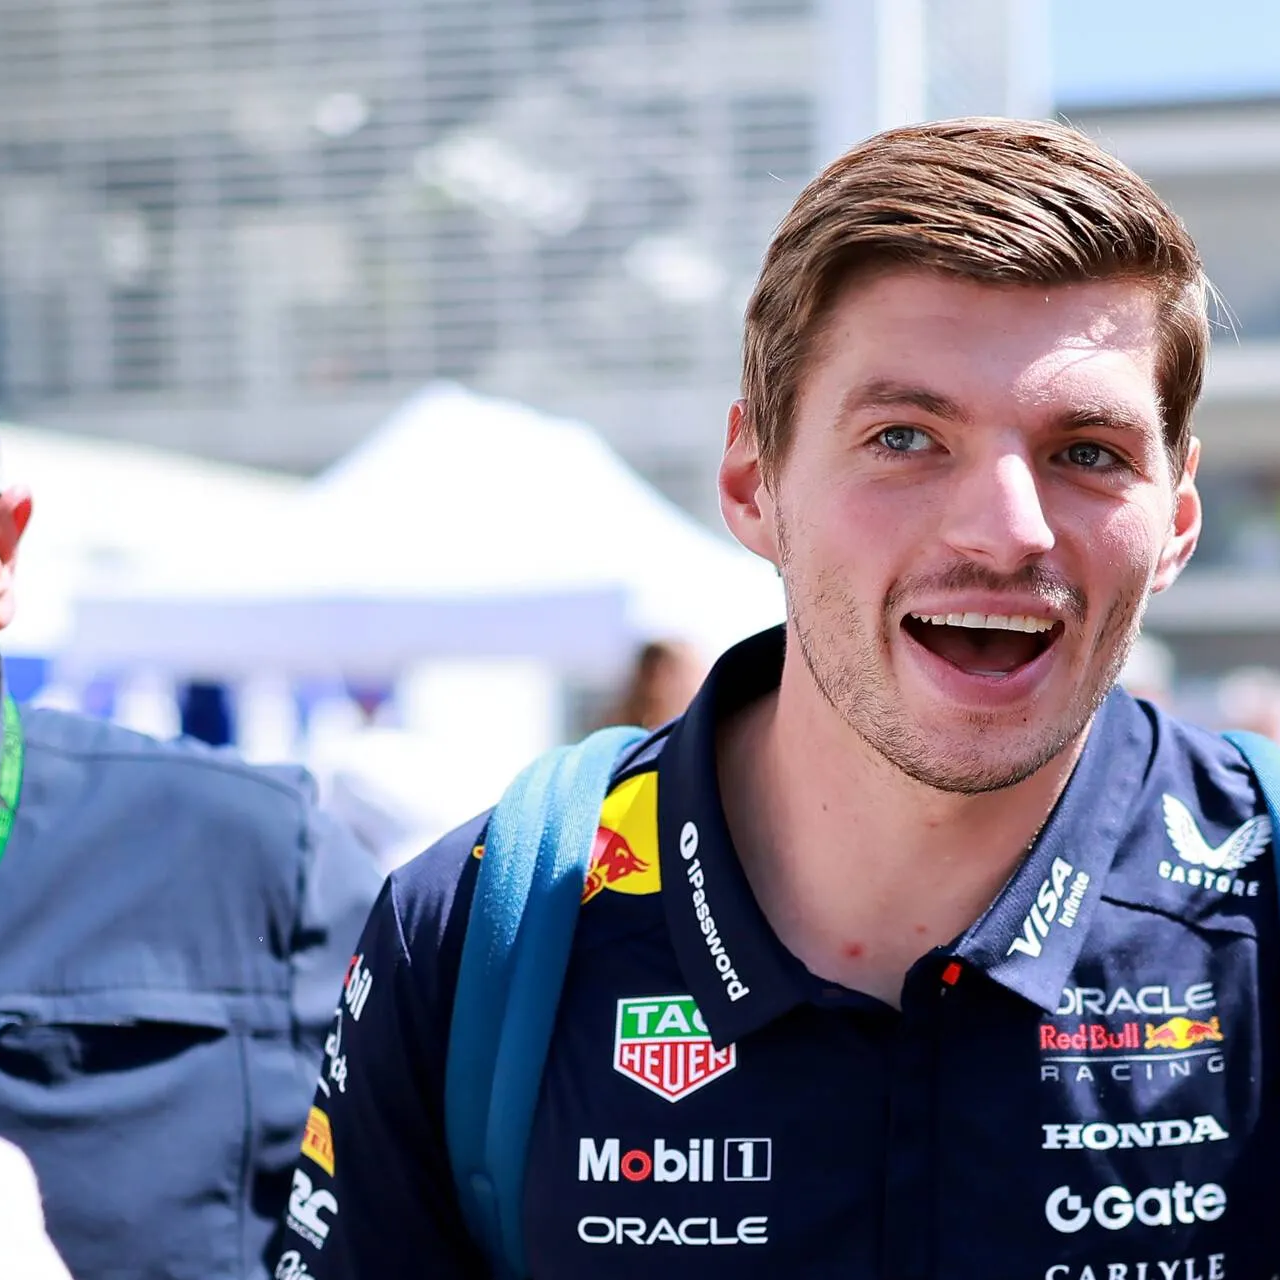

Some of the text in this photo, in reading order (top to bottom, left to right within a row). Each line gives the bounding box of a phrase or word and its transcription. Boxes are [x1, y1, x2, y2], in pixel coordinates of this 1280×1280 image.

[1158, 861, 1260, 897] CASTORE
[1007, 857, 1073, 958] VISA
[1057, 871, 1091, 929] Infinite
[686, 857, 750, 1002] 1Password
[1039, 1022, 1140, 1050] Red Bull
[1041, 1055, 1225, 1082] RACING
[1041, 1115, 1230, 1150] HONDA
[578, 1138, 714, 1183] Mobil
[577, 1216, 769, 1246] ORACLE
